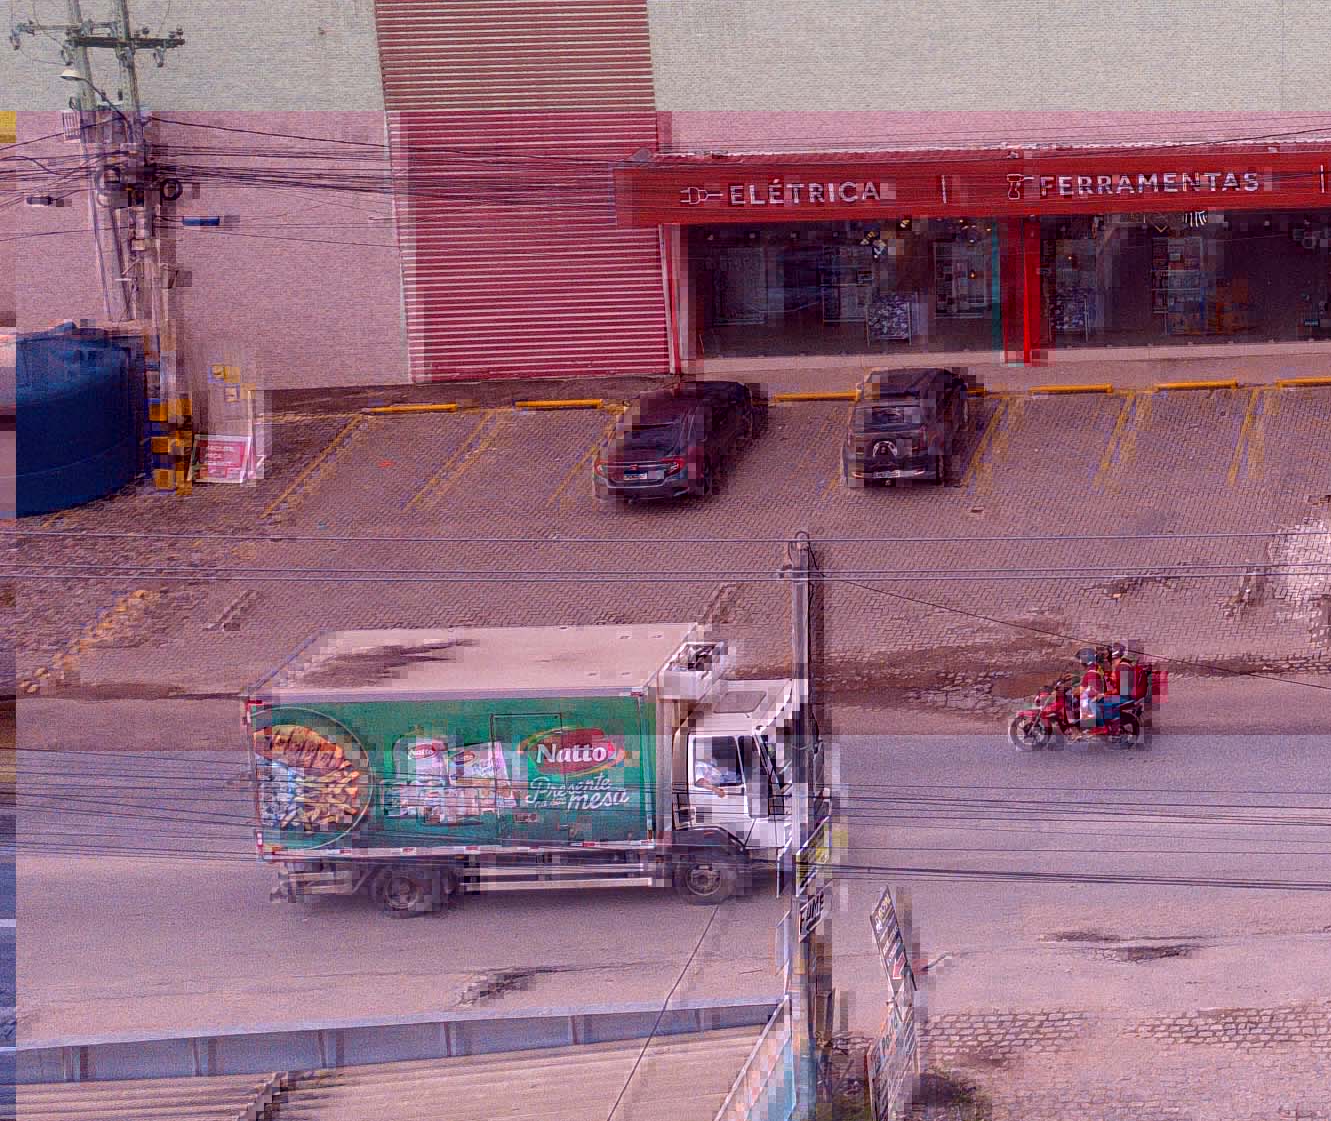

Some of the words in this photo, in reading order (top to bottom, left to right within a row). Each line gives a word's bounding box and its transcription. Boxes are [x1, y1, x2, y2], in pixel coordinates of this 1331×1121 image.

[729, 179, 880, 206] ELÉTRICA
[1039, 171, 1261, 198] FERRAMENTAS
[536, 742, 609, 763] Natto
[526, 775, 612, 804] Presente
[567, 788, 630, 811] mesa
